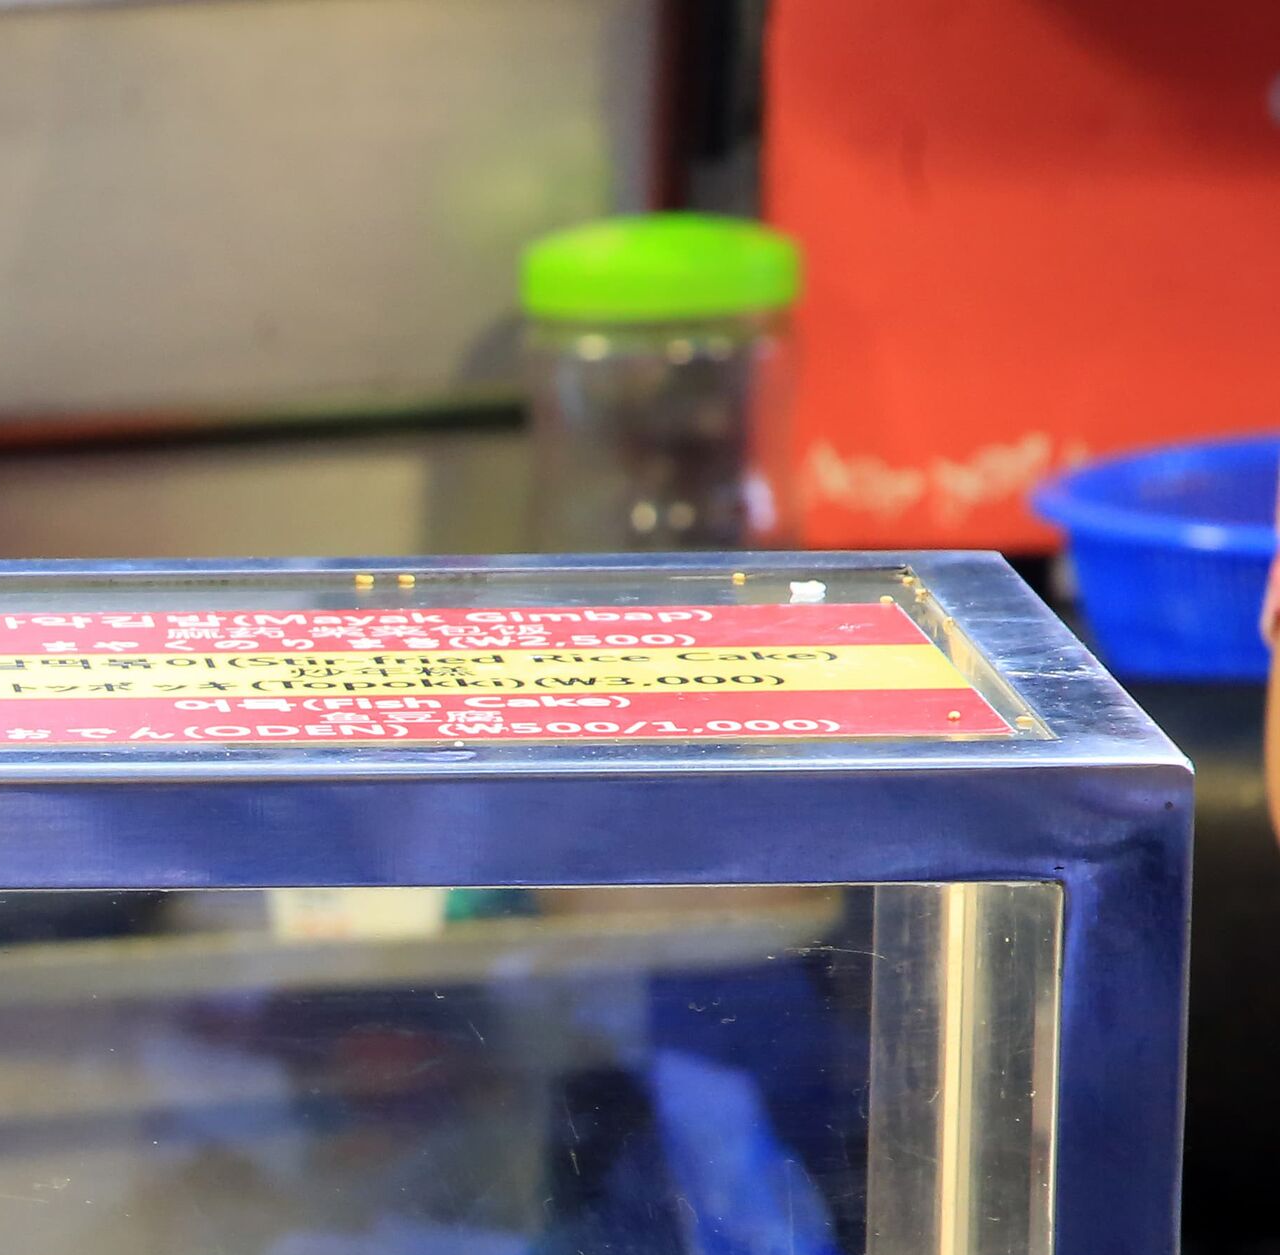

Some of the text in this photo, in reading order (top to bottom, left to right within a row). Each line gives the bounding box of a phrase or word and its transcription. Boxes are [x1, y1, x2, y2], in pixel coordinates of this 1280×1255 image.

[465, 610, 713, 623] Gimbap)
[532, 653, 650, 664] Rice
[676, 651, 838, 662] Cake)
[465, 695, 631, 709] Cake)
